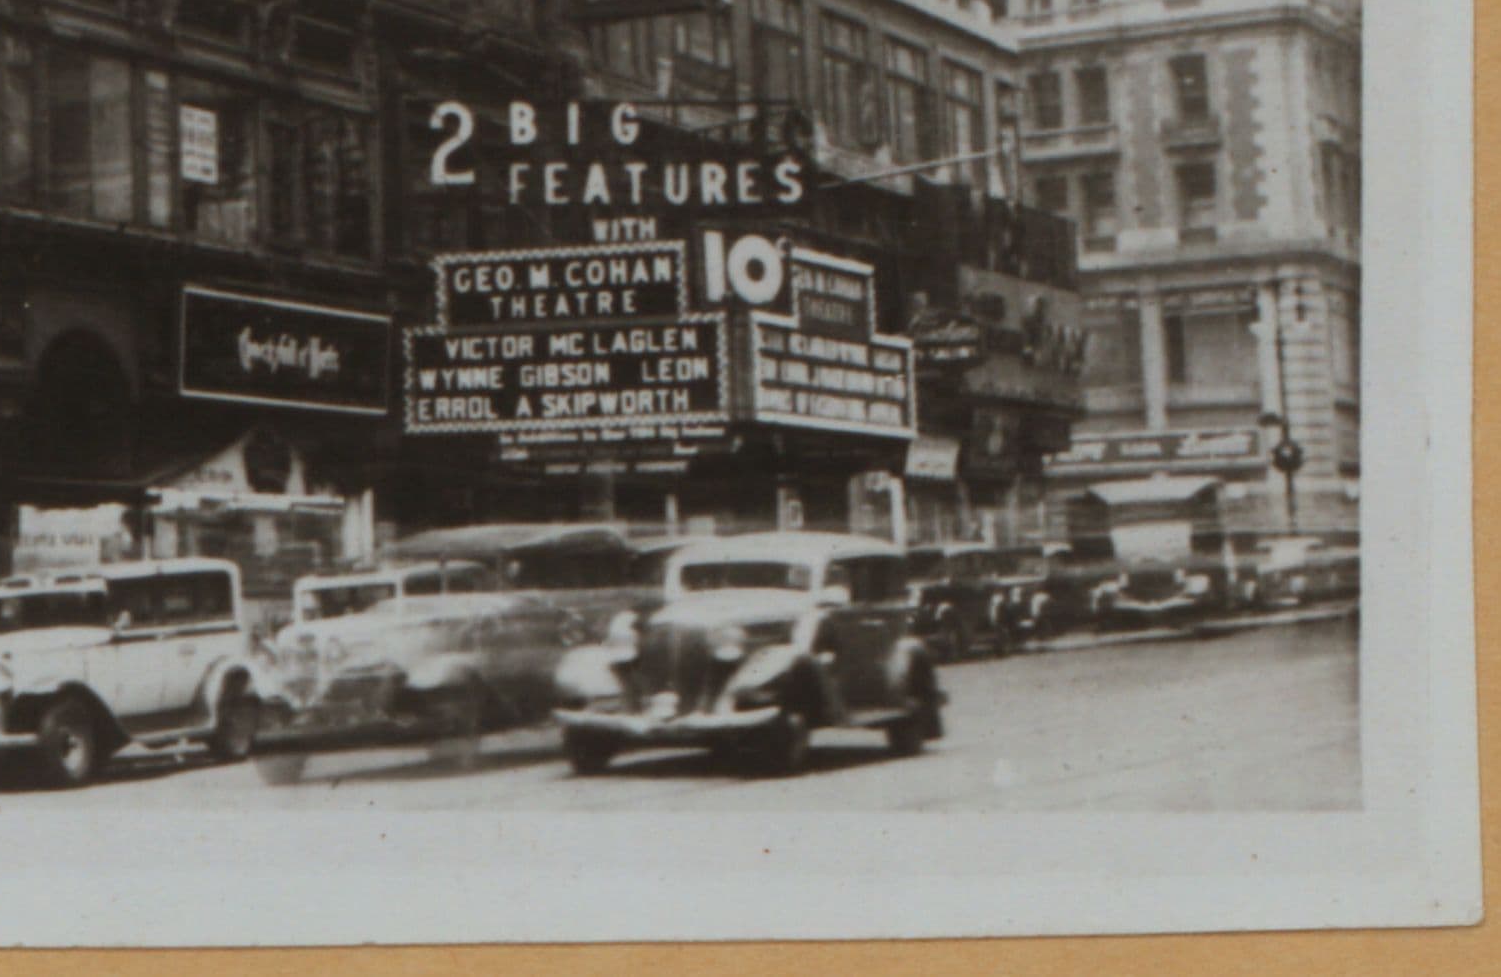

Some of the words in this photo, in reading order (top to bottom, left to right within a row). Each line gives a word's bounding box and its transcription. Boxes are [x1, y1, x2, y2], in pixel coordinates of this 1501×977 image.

[429, 102, 475, 185] 2
[509, 102, 640, 145] BIG
[509, 155, 803, 204] FEATURES
[592, 218, 656, 242] WITH
[565, 256, 672, 288] COHAN
[490, 289, 637, 318] THEATRE
[445, 332, 535, 361] VICTOR
[419, 366, 505, 391] WYNNE
[520, 361, 610, 388] GIBSON
[641, 356, 709, 384] LEON
[417, 396, 497, 422] ERROL
[515, 394, 534, 419] A
[542, 388, 690, 416] SKIPWORTH
